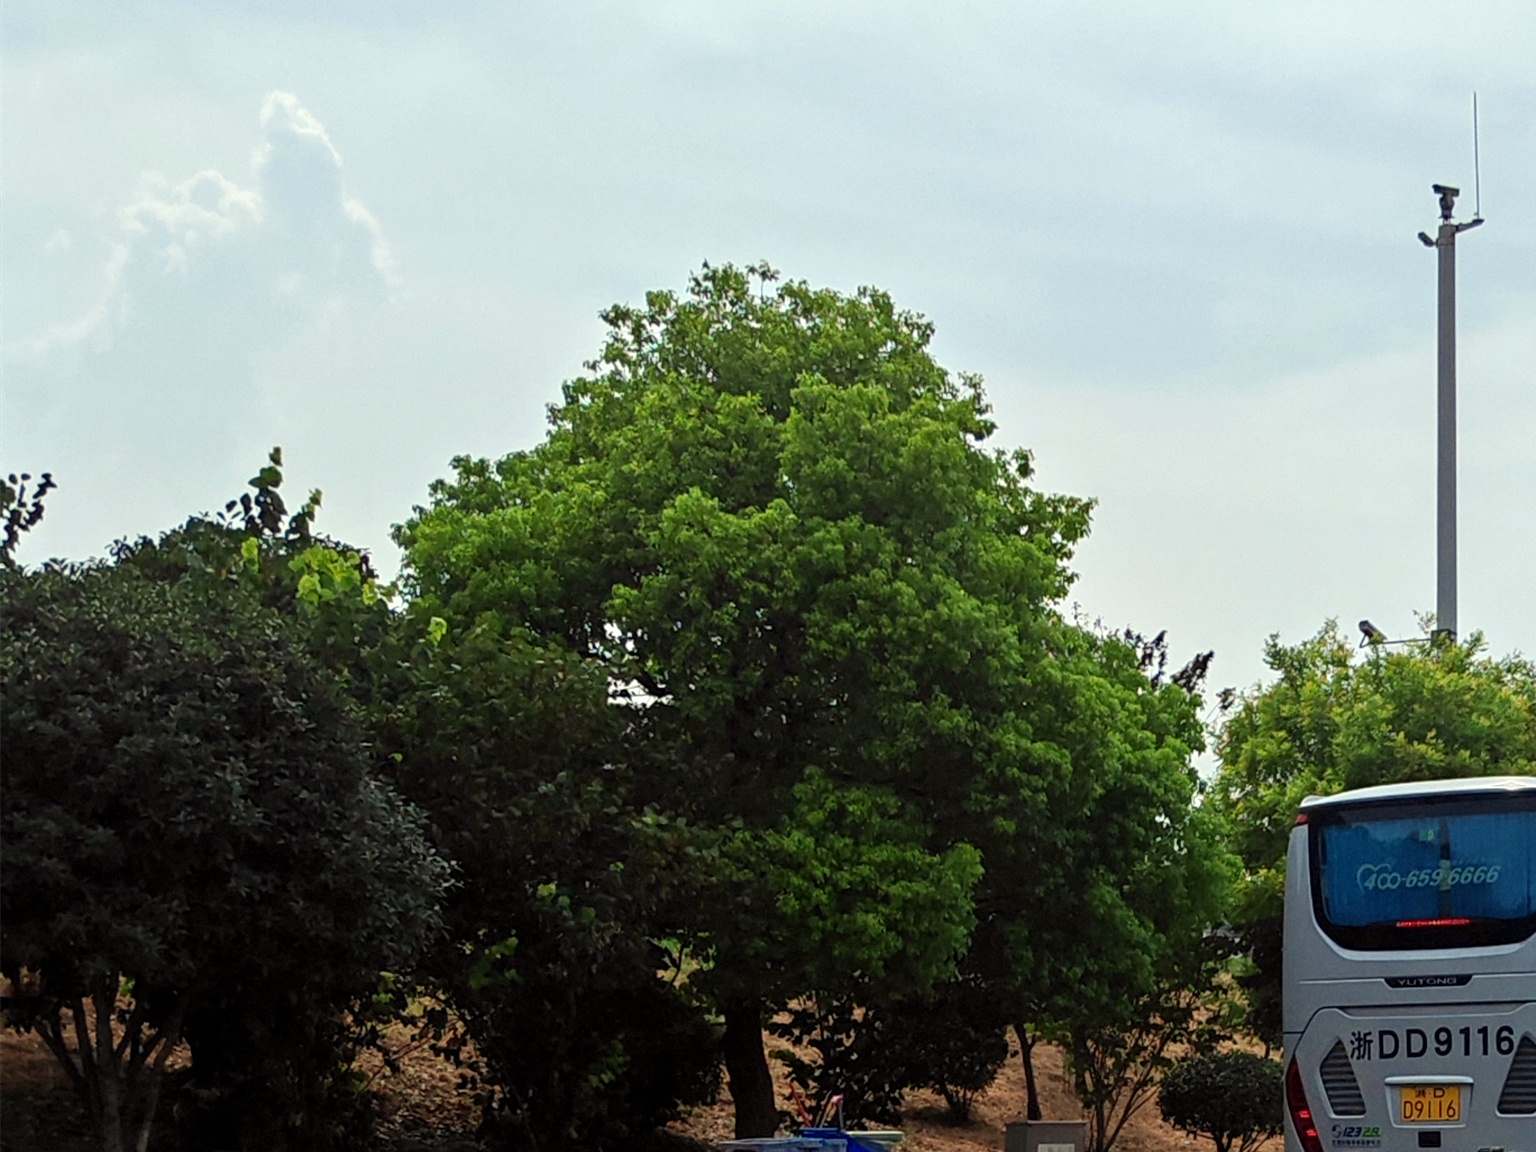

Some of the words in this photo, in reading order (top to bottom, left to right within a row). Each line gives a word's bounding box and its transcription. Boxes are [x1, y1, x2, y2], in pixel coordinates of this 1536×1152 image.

[1398, 976, 1457, 986] YUTONG
[1350, 1025, 1514, 1061] 浙DD9116
[1403, 1100, 1457, 1120] D9116
